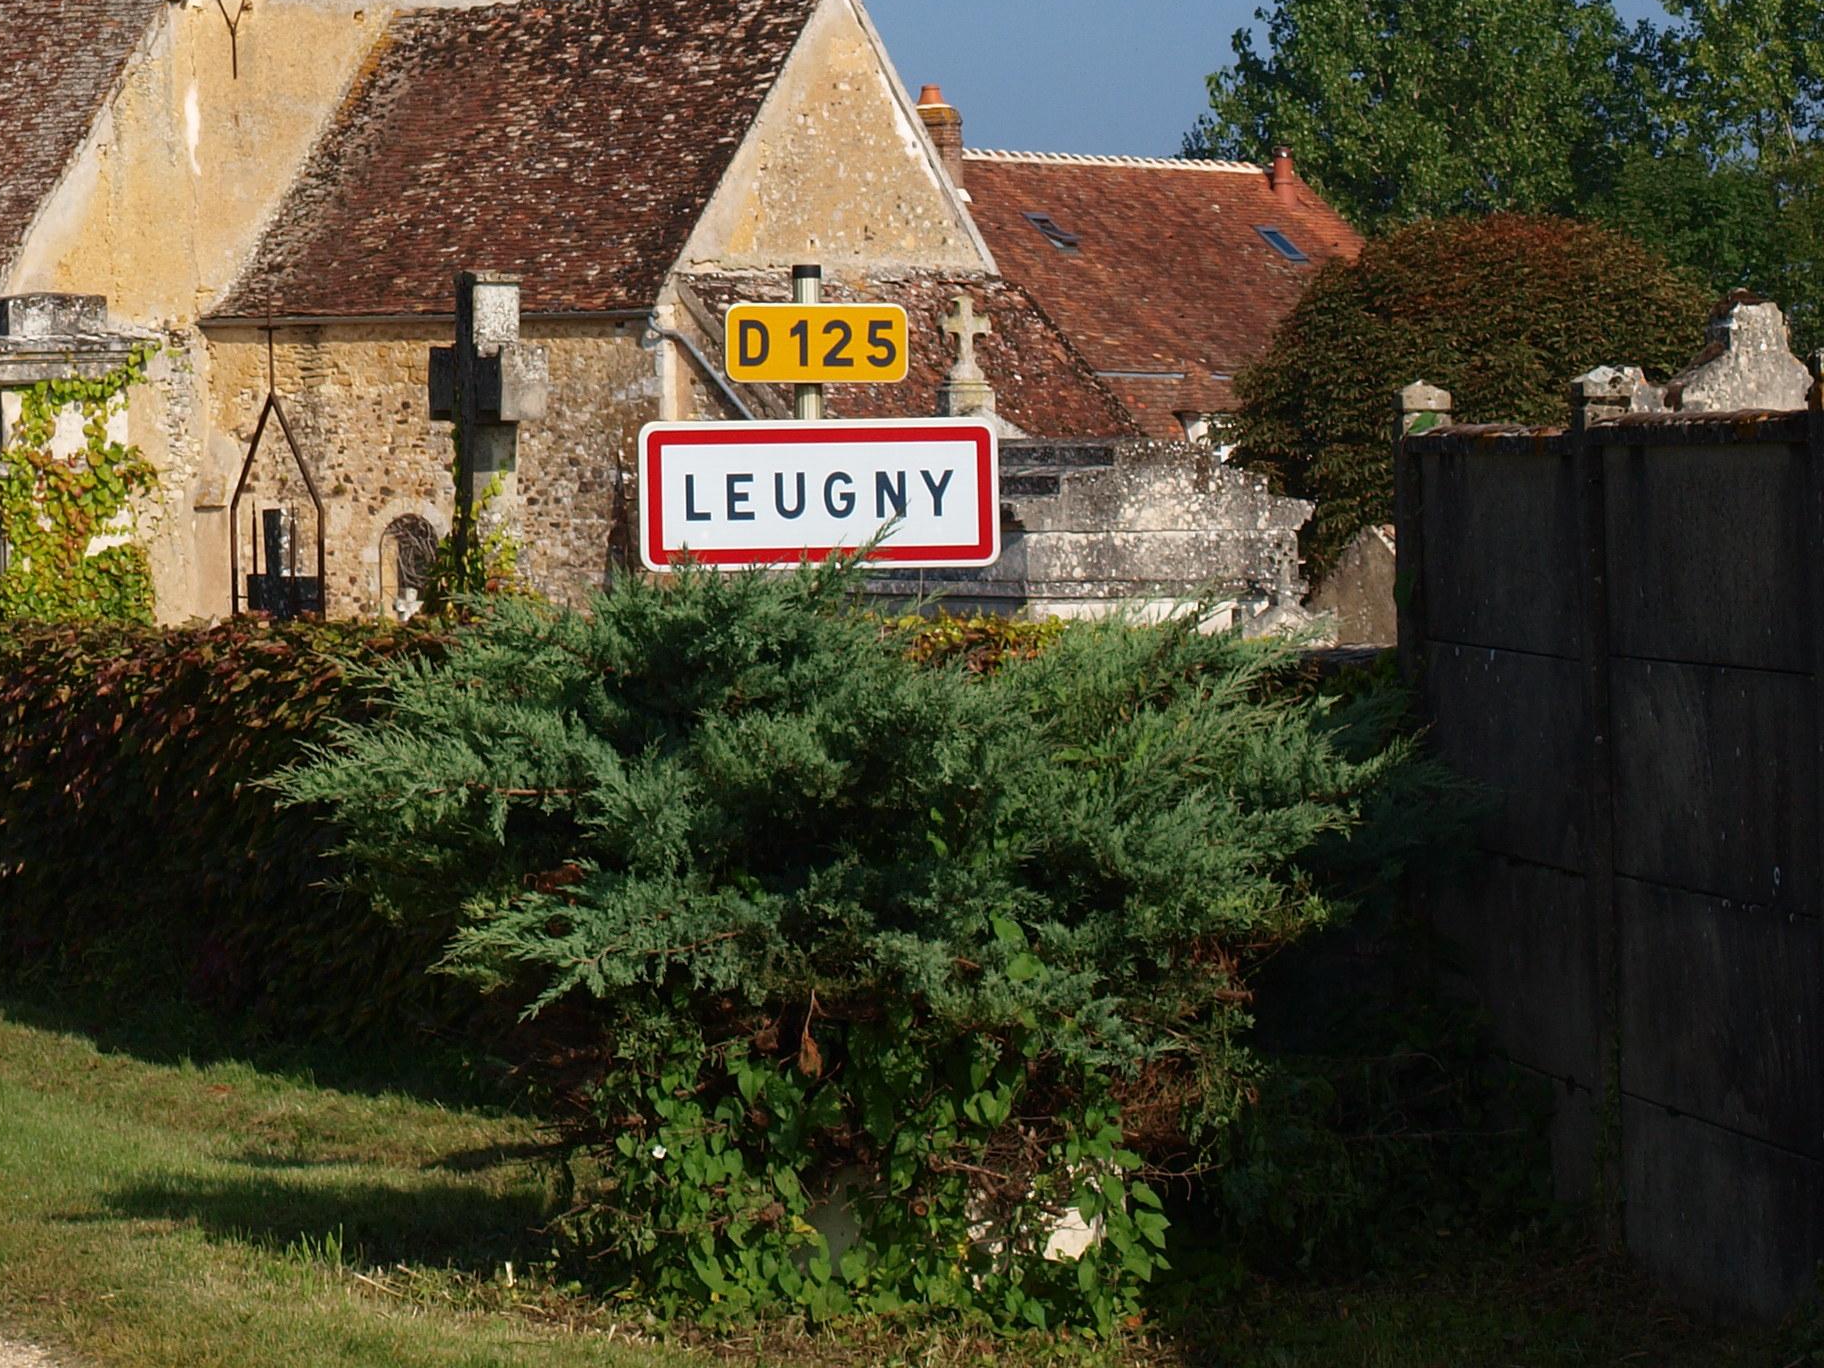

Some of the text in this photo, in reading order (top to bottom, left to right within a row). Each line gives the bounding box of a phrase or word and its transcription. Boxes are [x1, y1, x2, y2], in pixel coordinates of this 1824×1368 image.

[738, 319, 897, 367] D 125
[685, 469, 954, 521] LEUGNY
